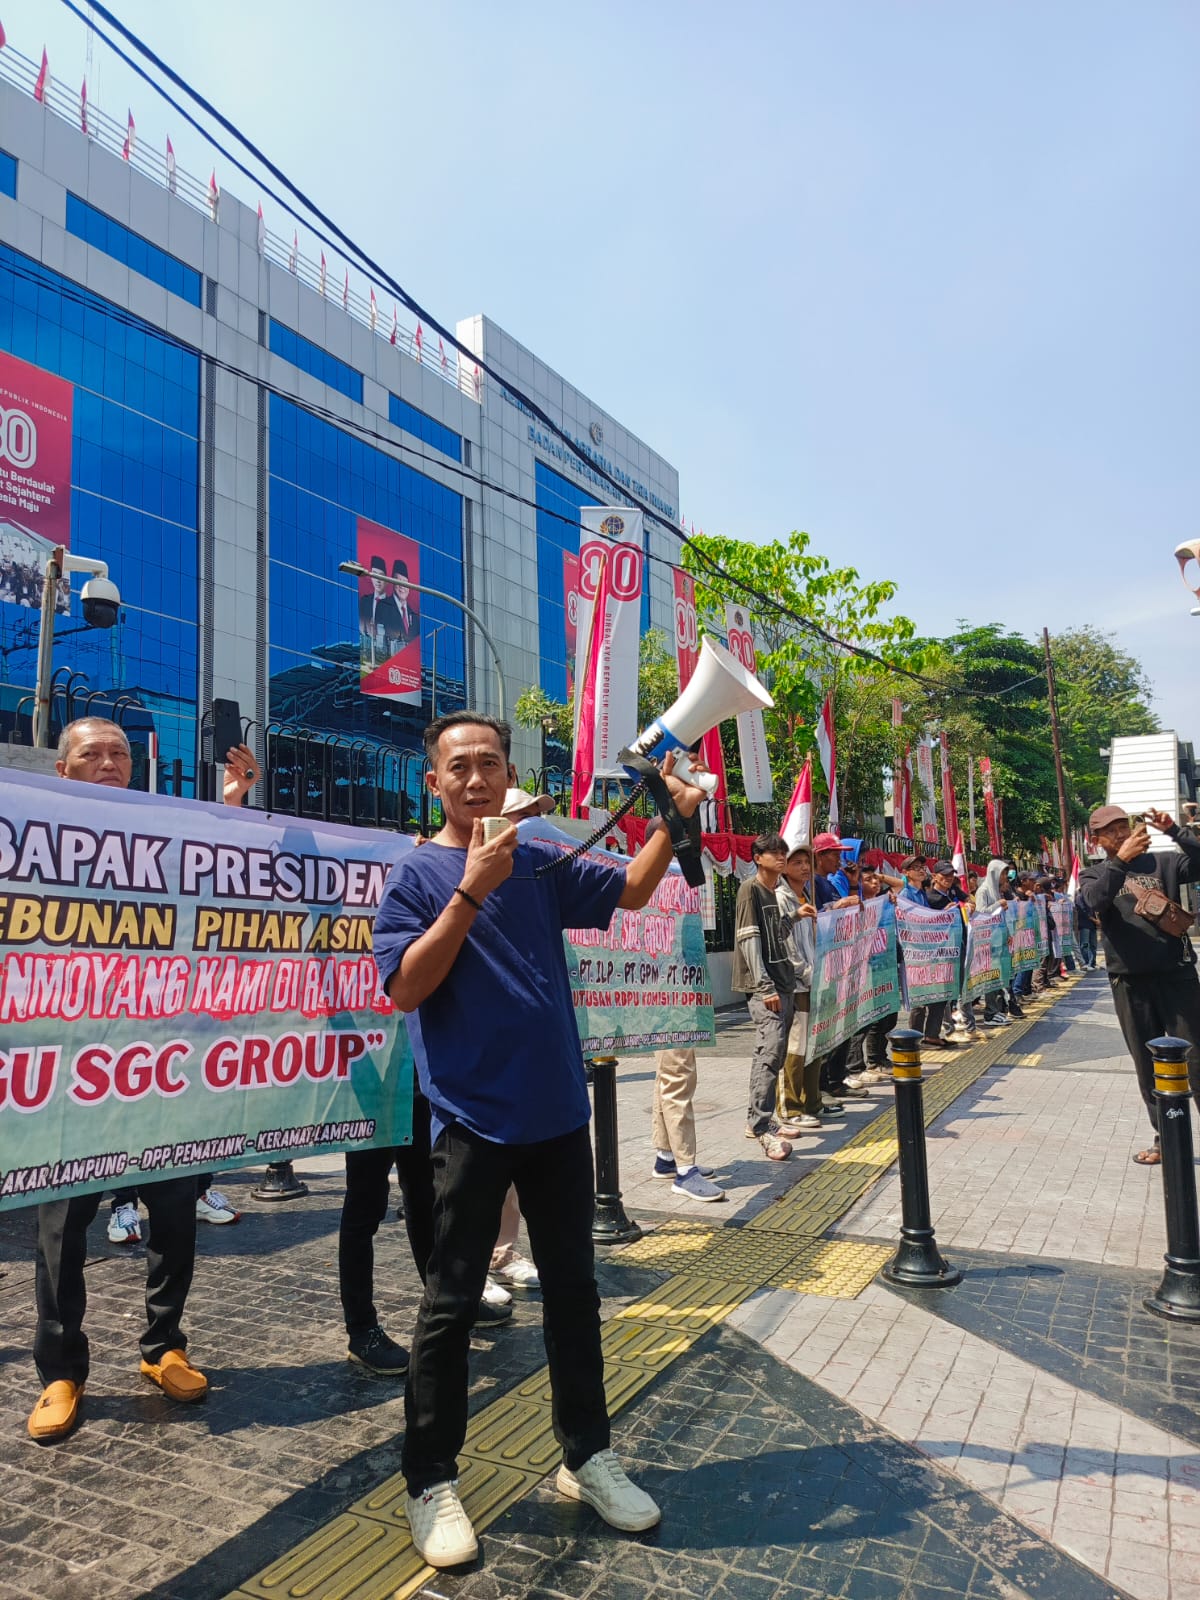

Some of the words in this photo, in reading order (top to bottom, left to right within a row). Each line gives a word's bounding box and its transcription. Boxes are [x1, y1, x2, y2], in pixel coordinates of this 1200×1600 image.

[6, 481, 51, 505] Sejahtera
[10, 470, 56, 495] Berdaulat
[18, 497, 40, 513] Maju
[601, 665, 611, 709] REPUBLIK
[600, 711, 609, 760] INDONESIA
[180, 839, 394, 907] PRESIDEN
[193, 905, 305, 952] PIHAK
[621, 911, 642, 952] SGC
[188, 953, 270, 1021] KAMI
[270, 956, 303, 1013] DI
[580, 958, 593, 984] PT.
[624, 961, 638, 985] PT.
[640, 963, 660, 985] GPM
[666, 964, 680, 986] PT.
[681, 991, 703, 1007] DPR
[66, 1039, 194, 1107] SGC
[50, 1152, 127, 1188] LAMPUNG
[139, 1145, 173, 1171] DPP
[172, 1135, 246, 1167] PEMATANK
